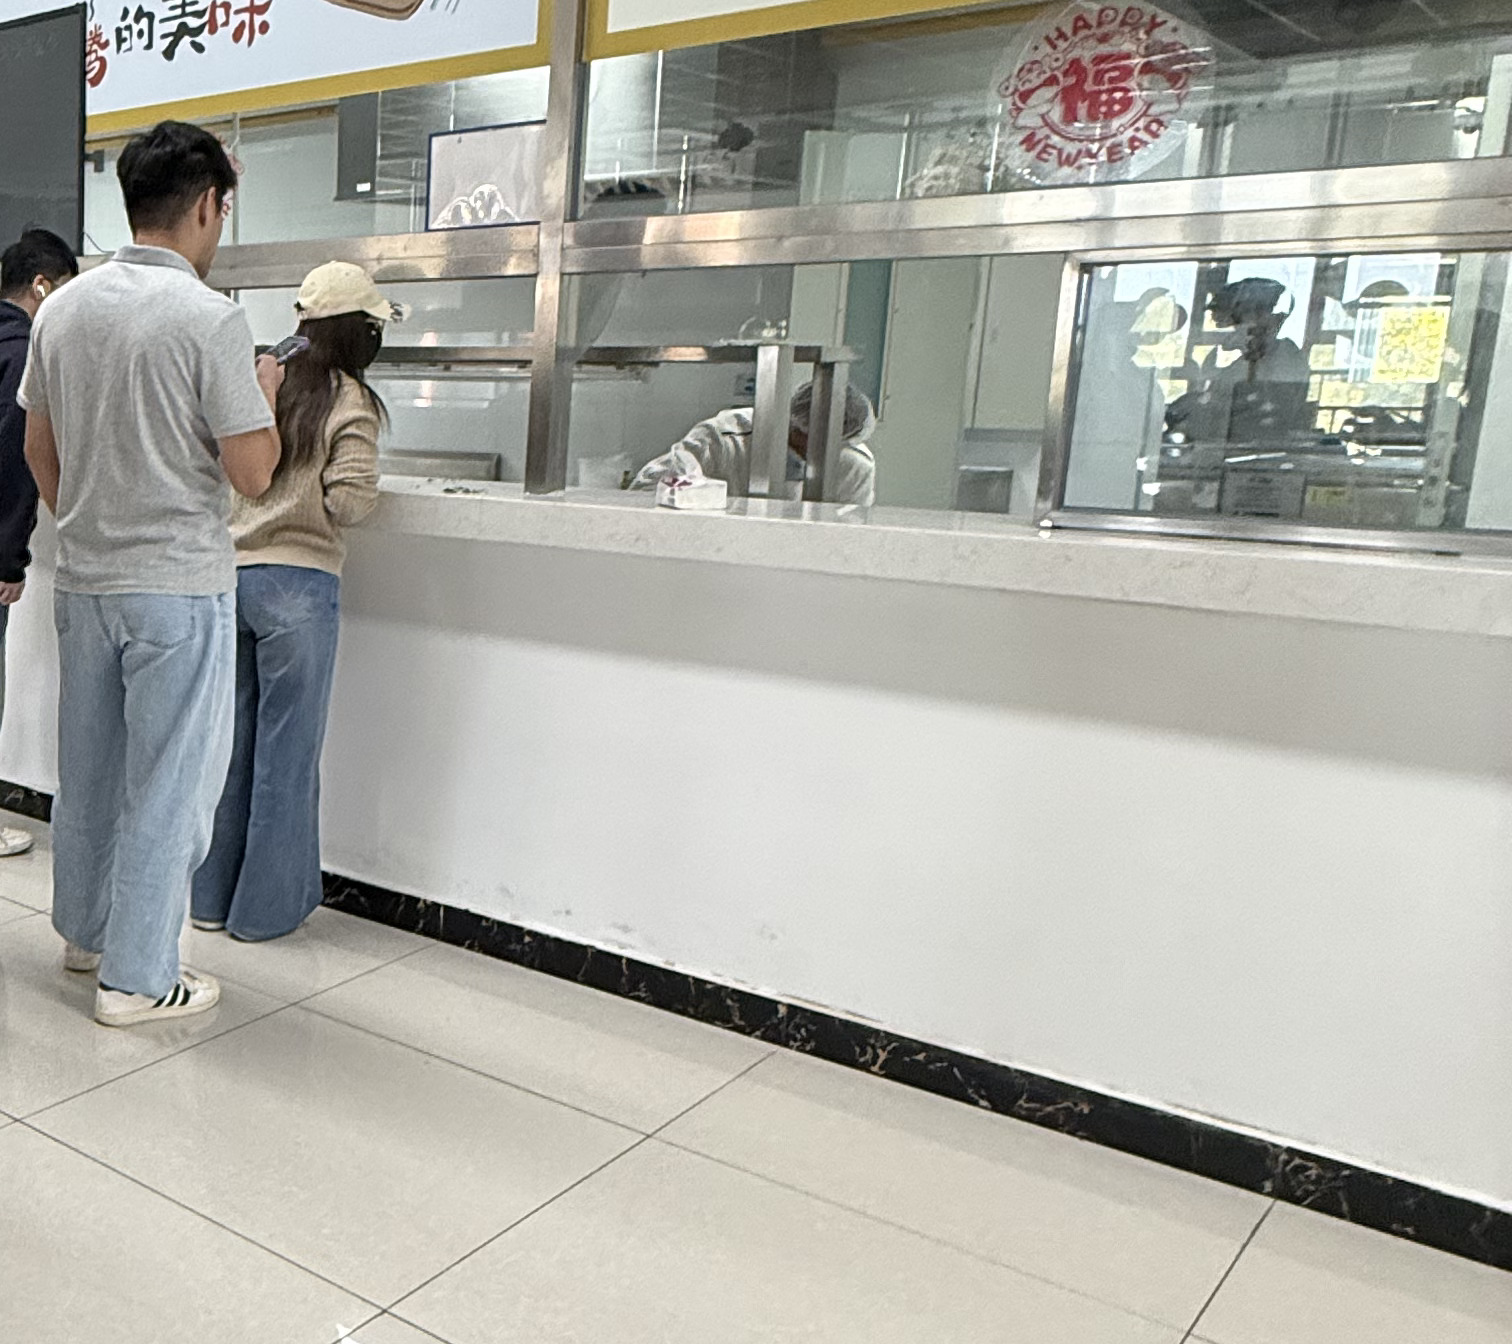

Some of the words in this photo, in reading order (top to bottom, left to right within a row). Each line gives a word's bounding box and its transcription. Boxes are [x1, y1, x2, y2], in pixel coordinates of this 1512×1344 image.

[1043, 6, 1168, 51] HAPPY
[1060, 52, 1136, 124] 福
[1019, 130, 1083, 170] NEW
[1082, 118, 1169, 163] YEAR
